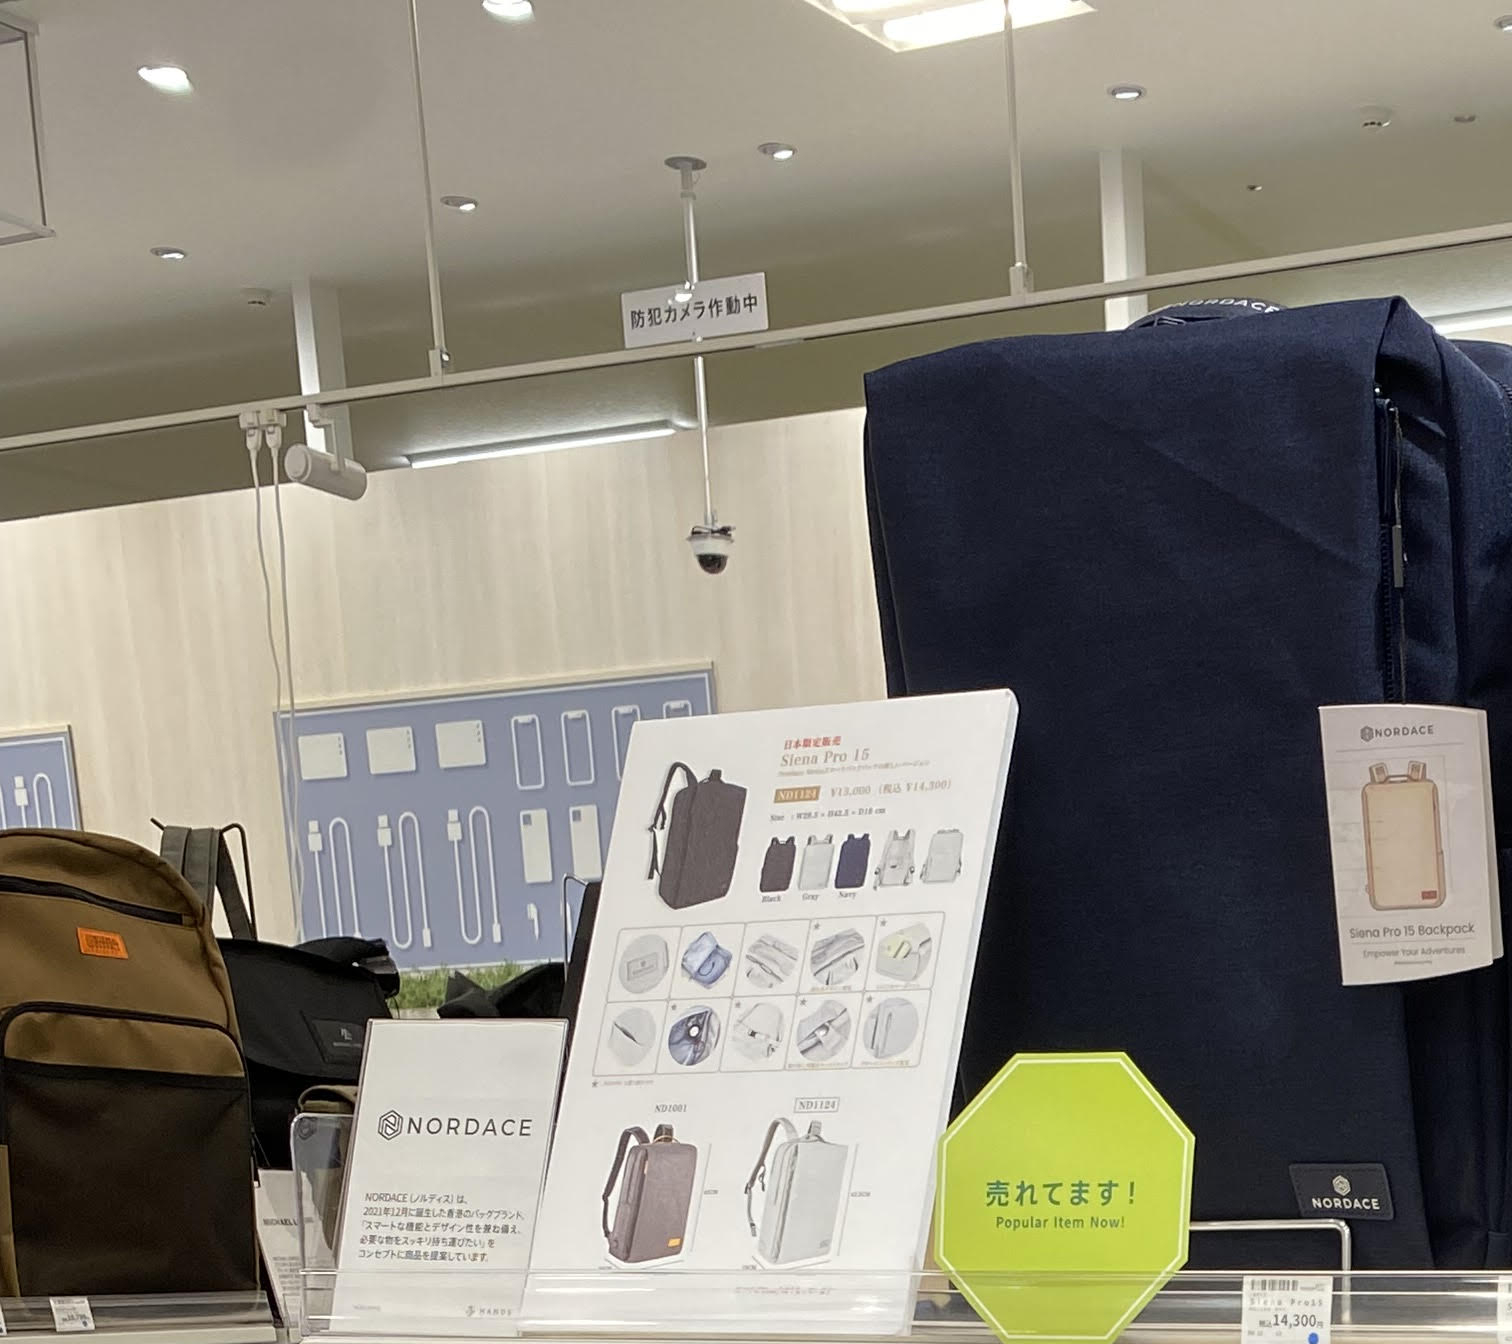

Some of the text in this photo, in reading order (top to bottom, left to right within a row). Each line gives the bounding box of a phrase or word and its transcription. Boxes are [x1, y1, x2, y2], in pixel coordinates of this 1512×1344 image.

[629, 293, 758, 330] 防犯カメラ作動中
[1375, 725, 1434, 738] NORDACE
[780, 748, 870, 767] Siena Pro 15
[1350, 922, 1475, 939] Siena Pro 15 Backpack
[798, 1100, 836, 1110] ND1124
[407, 1117, 533, 1137] NORDACE
[1312, 1197, 1380, 1211] NORDACE
[996, 1216, 1125, 1231] Popular Item Now!
